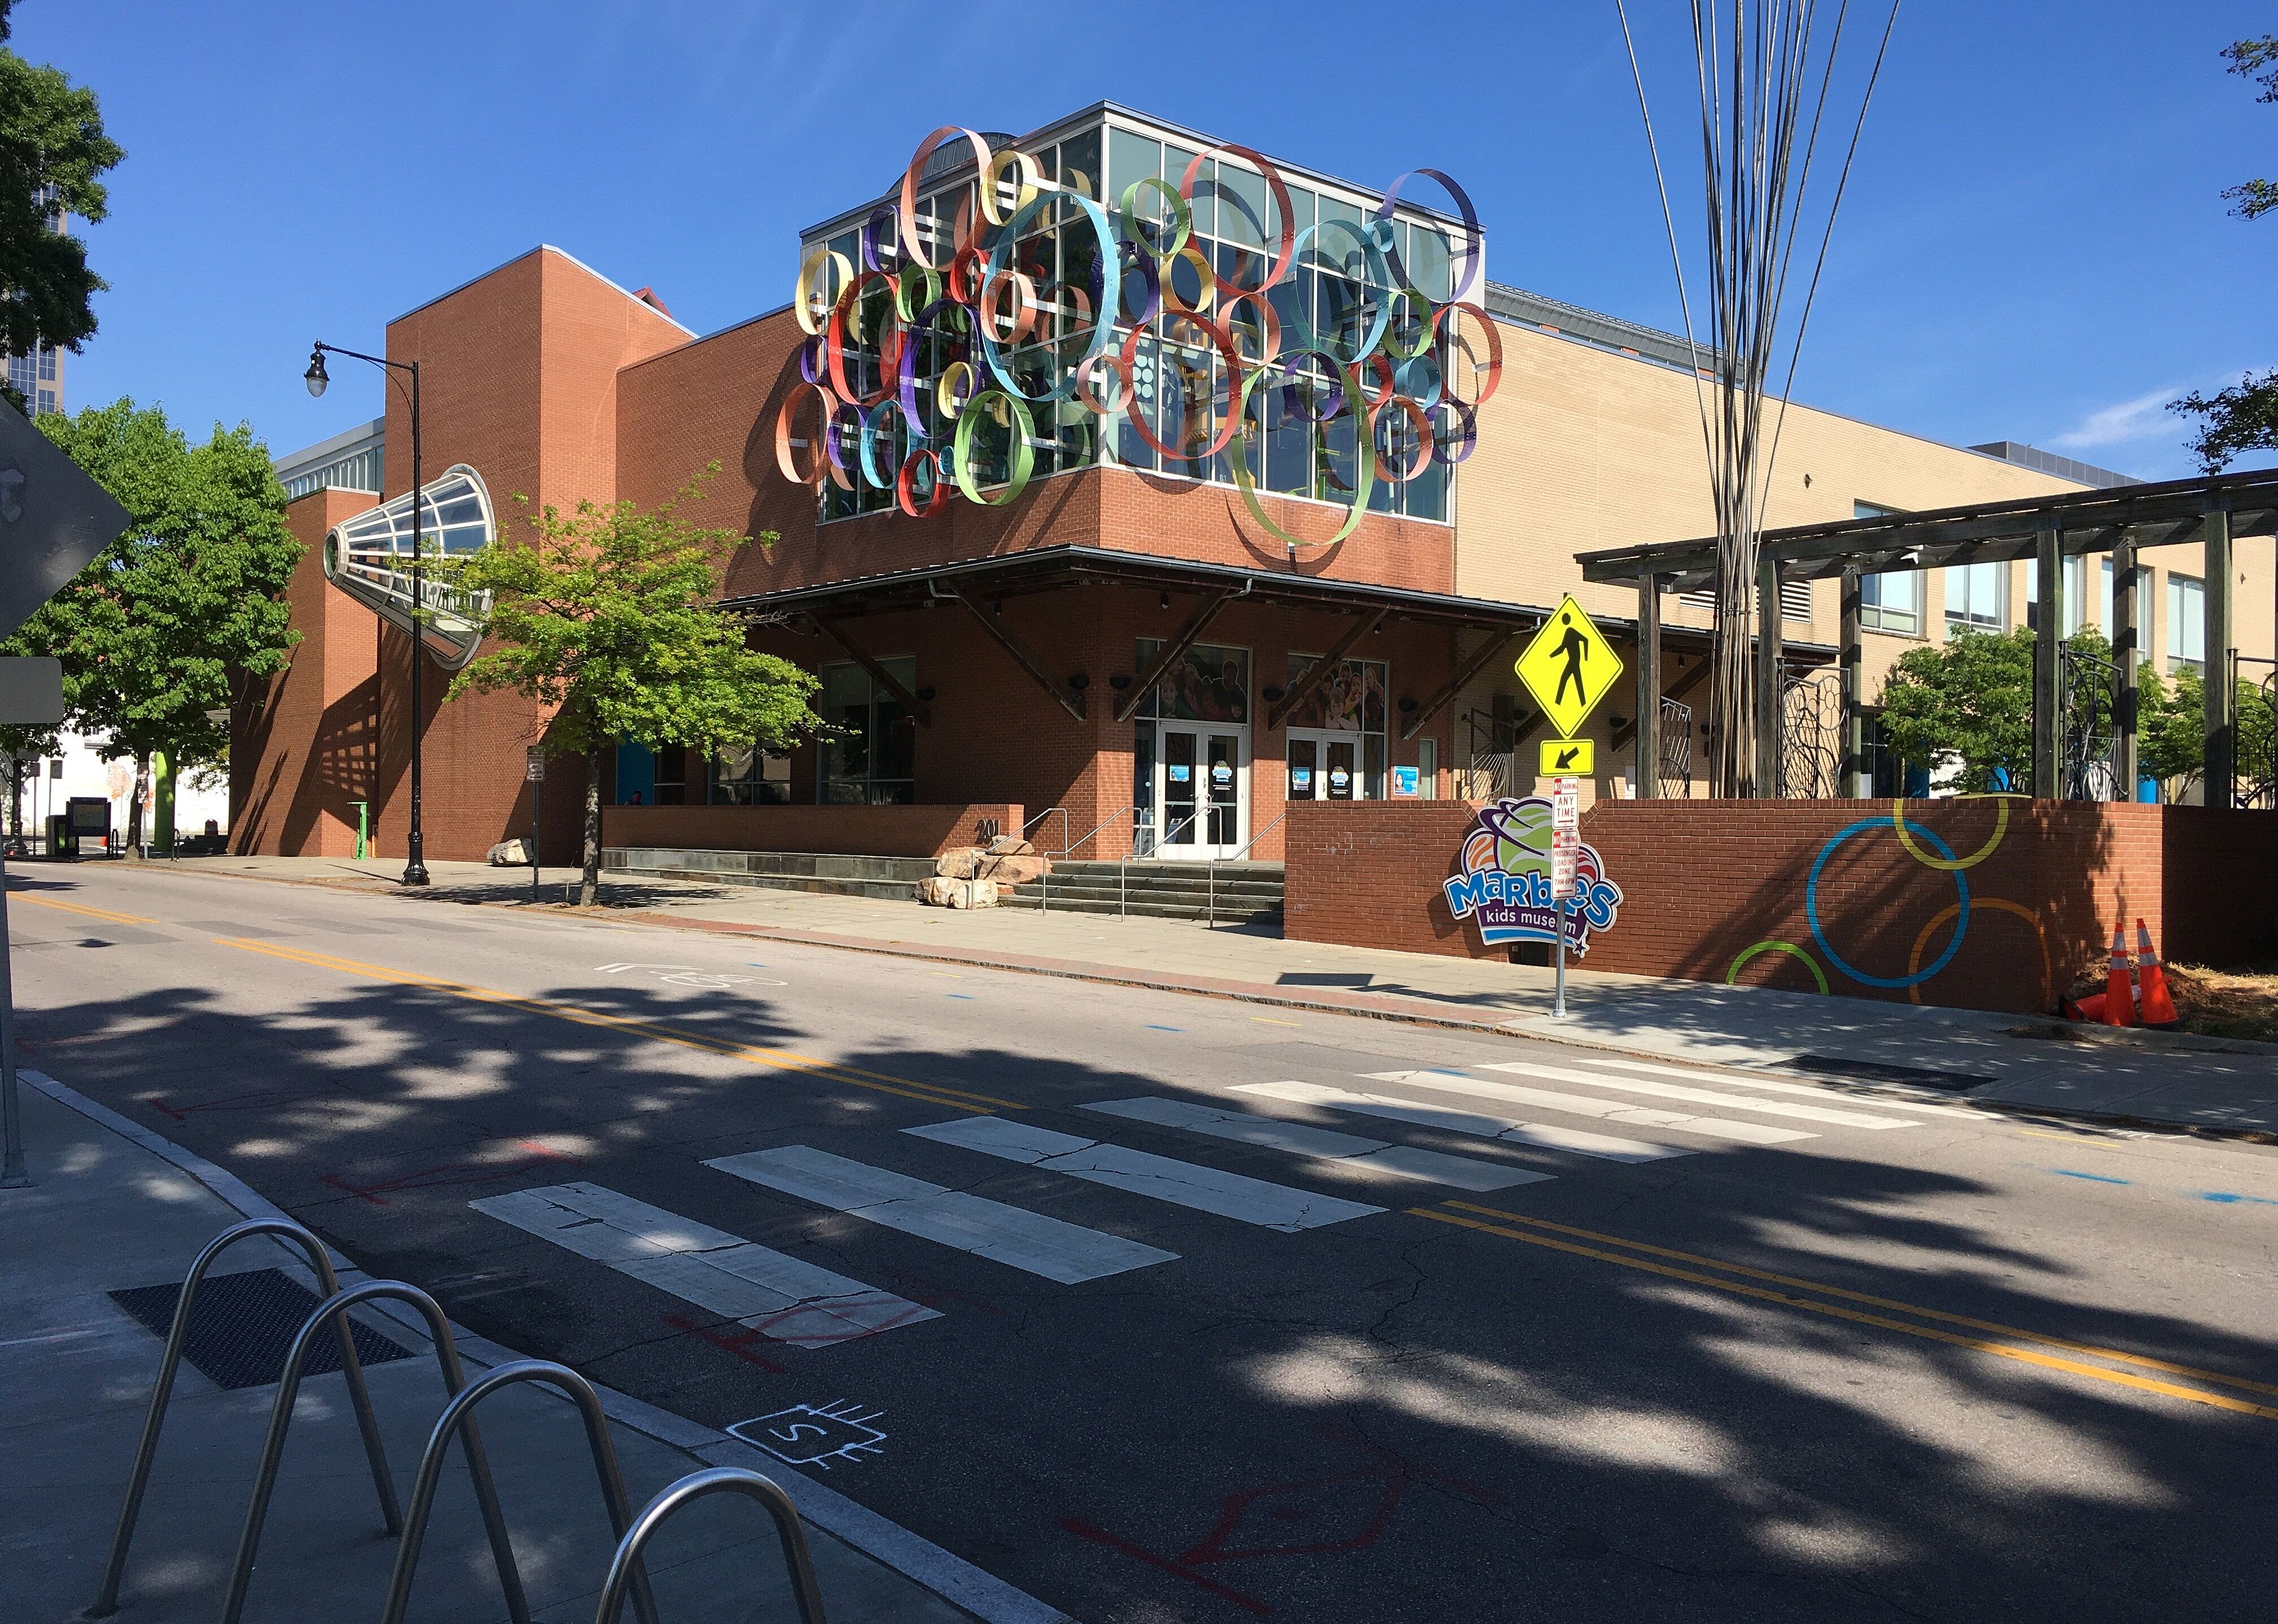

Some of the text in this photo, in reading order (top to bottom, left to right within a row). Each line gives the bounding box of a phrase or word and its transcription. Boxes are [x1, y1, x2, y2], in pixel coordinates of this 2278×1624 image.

[1554, 782, 1561, 792] NO
[1558, 796, 1574, 806] ANY
[1556, 807, 1575, 817] TIME
[977, 818, 1000, 839] 201
[1554, 835, 1560, 844] NO
[1486, 909, 1576, 935] kids musem
